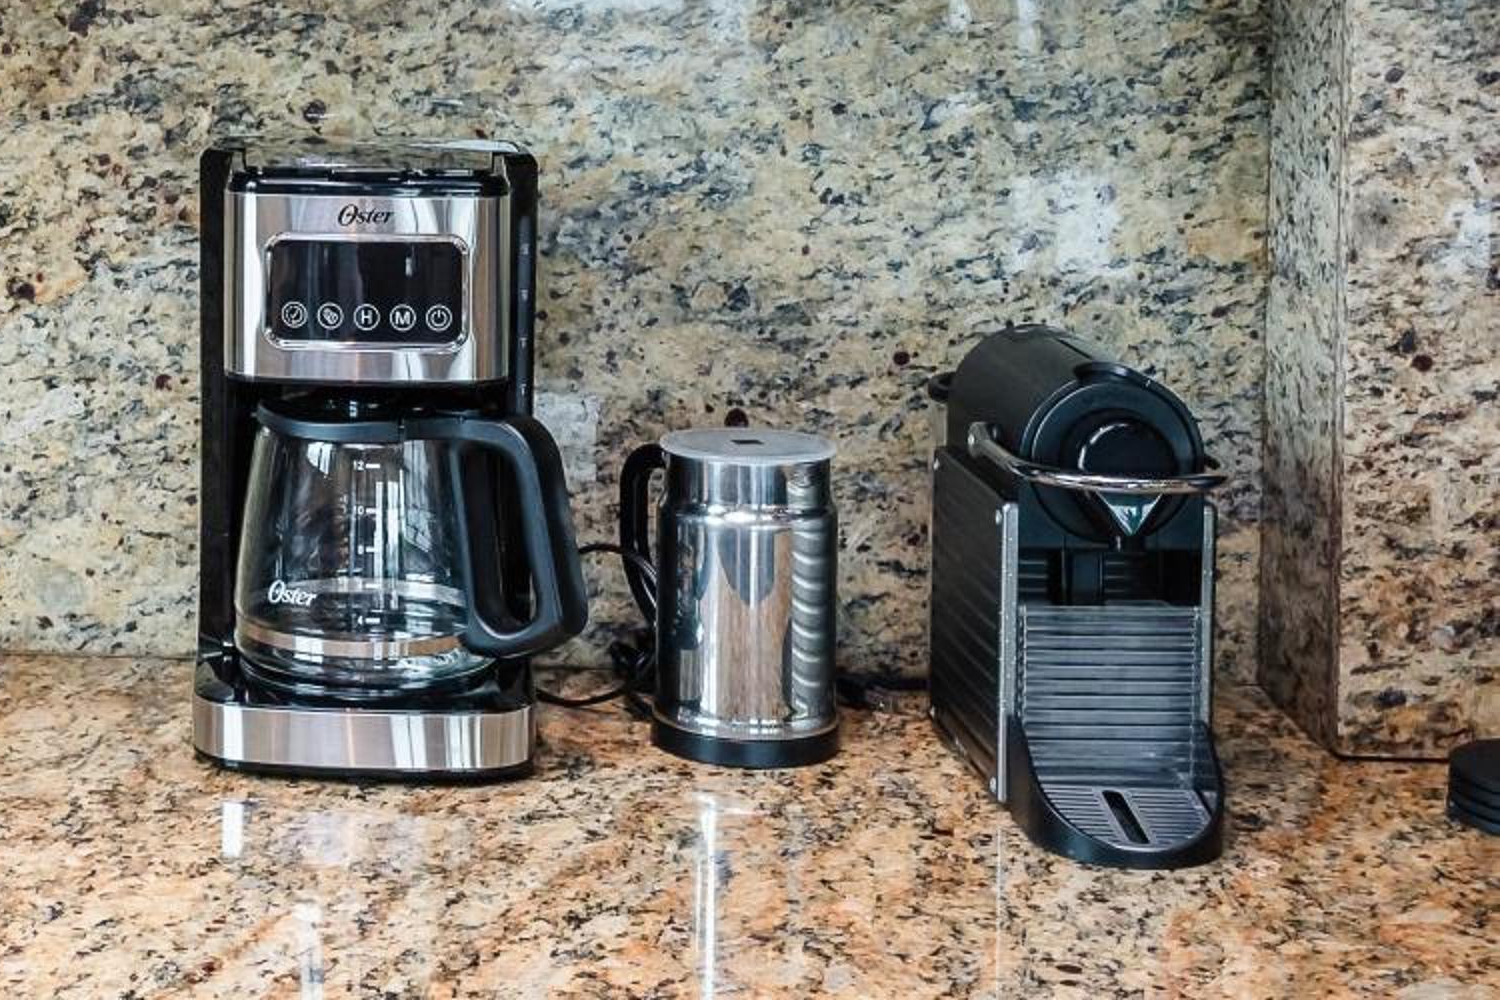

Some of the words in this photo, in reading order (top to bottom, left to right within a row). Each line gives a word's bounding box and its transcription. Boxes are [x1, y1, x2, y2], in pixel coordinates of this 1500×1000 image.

[338, 204, 393, 226] Oster
[361, 310, 373, 325] H
[395, 311, 410, 325] M
[352, 460, 365, 471] 12
[352, 505, 364, 515] 10
[268, 580, 317, 606] Oster
